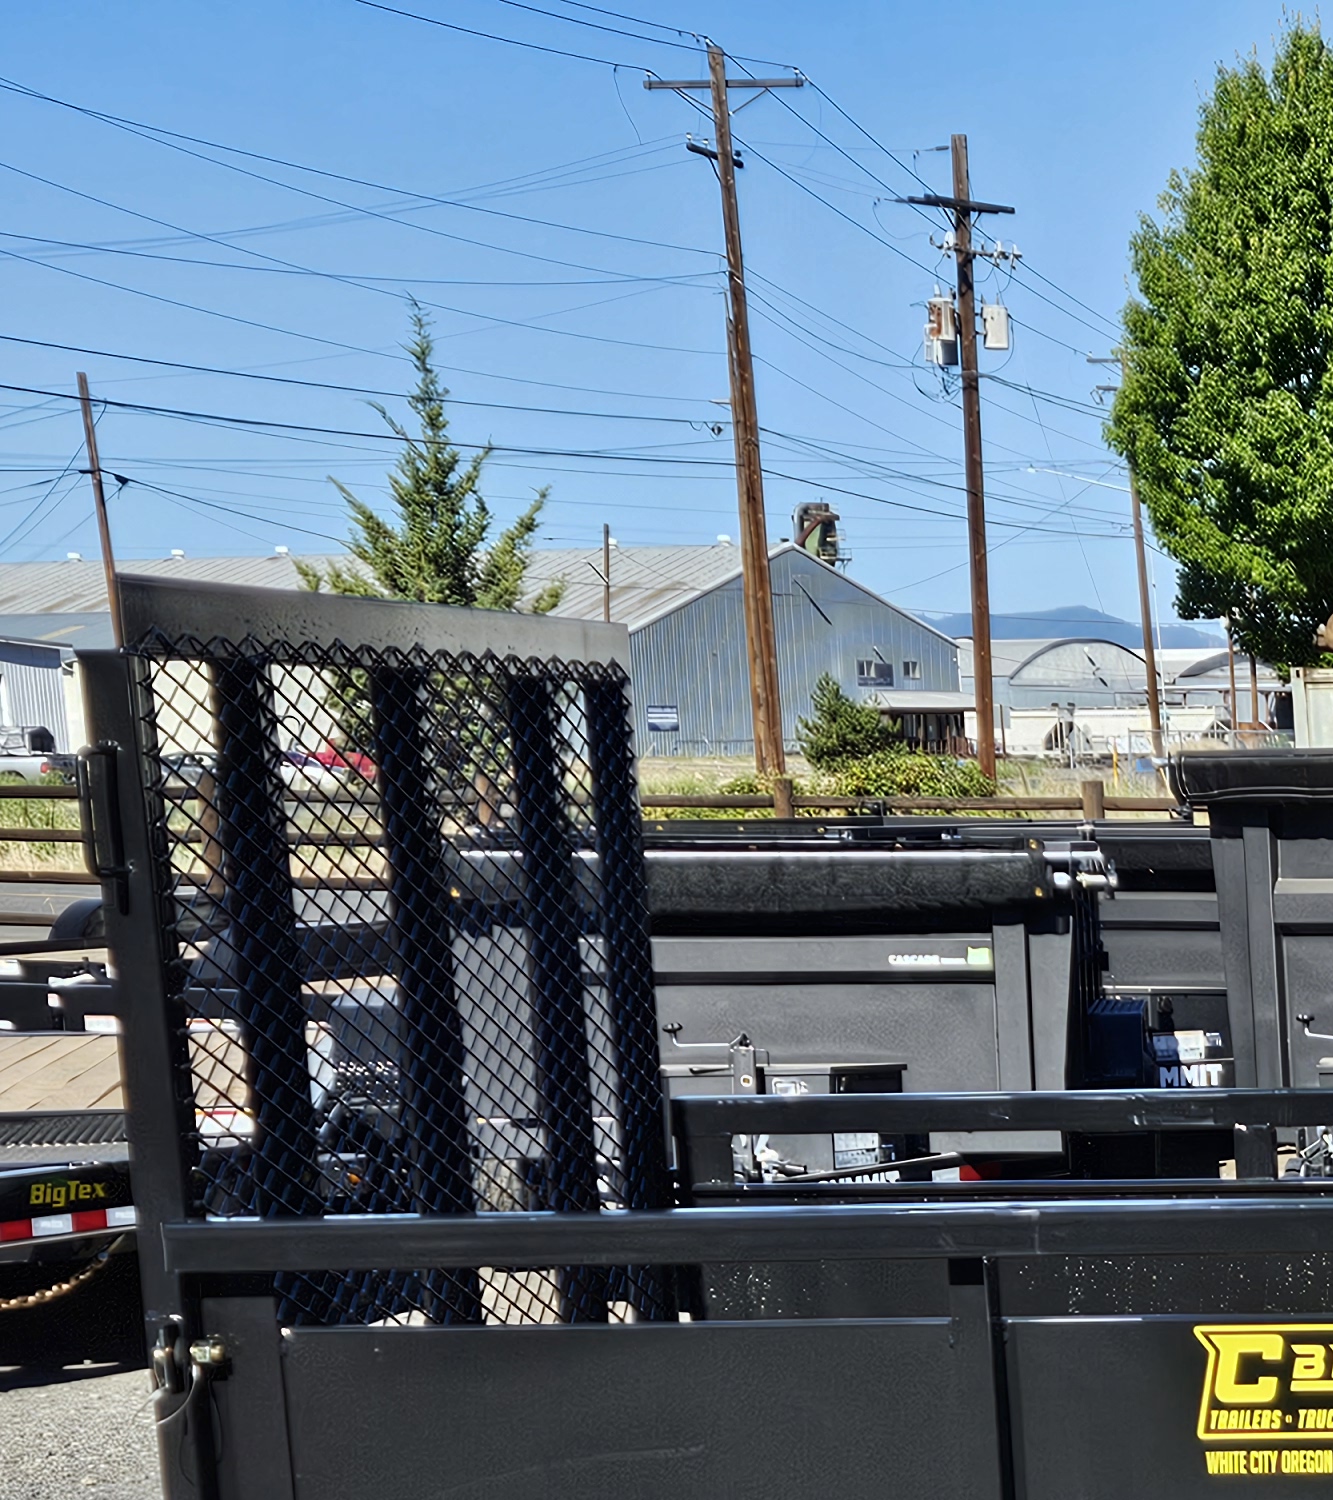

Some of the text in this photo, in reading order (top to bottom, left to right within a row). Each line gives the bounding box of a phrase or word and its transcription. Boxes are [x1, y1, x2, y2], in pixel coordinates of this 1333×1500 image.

[1160, 1063, 1223, 1088] MMIT
[29, 1180, 106, 1208] BigTex
[1208, 1333, 1284, 1403] C
[1210, 1409, 1283, 1430] TRAILERS
[1205, 1450, 1248, 1475] WHITE
[1249, 1450, 1279, 1474] CITY
[1281, 1449, 1333, 1474] OREGON
